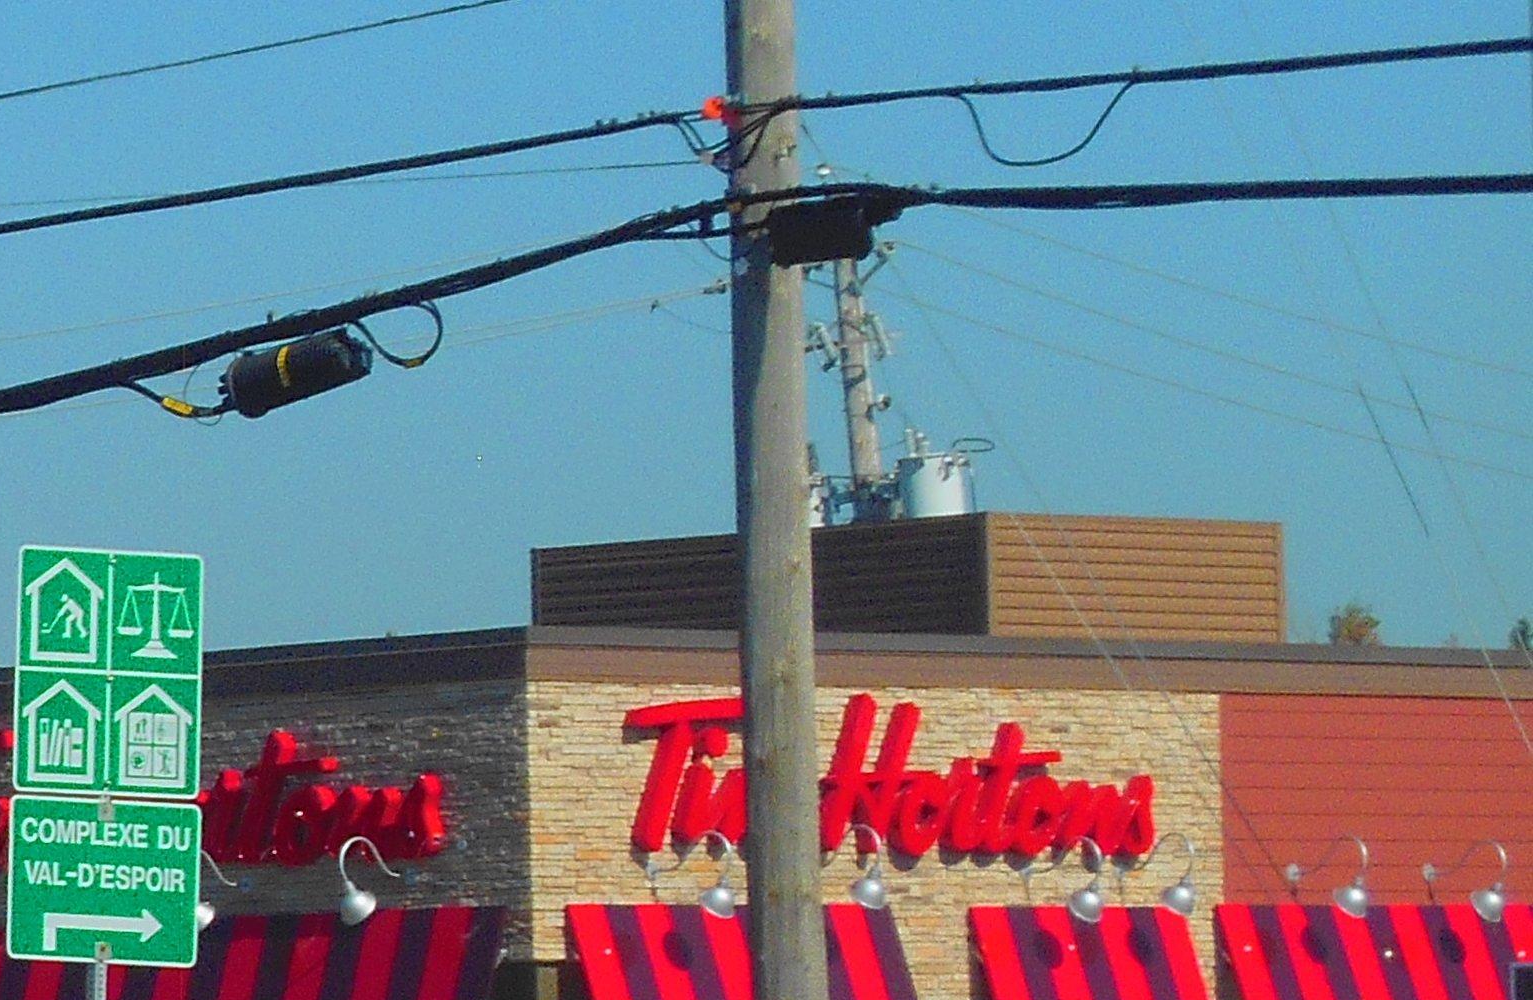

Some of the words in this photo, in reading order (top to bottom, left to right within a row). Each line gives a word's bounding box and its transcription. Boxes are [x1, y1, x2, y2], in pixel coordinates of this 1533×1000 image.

[820, 693, 1156, 857] Hortons
[20, 817, 149, 849] COMPLEXE
[157, 824, 193, 852] DU
[23, 859, 186, 893] VAL-D'ESPOIR
